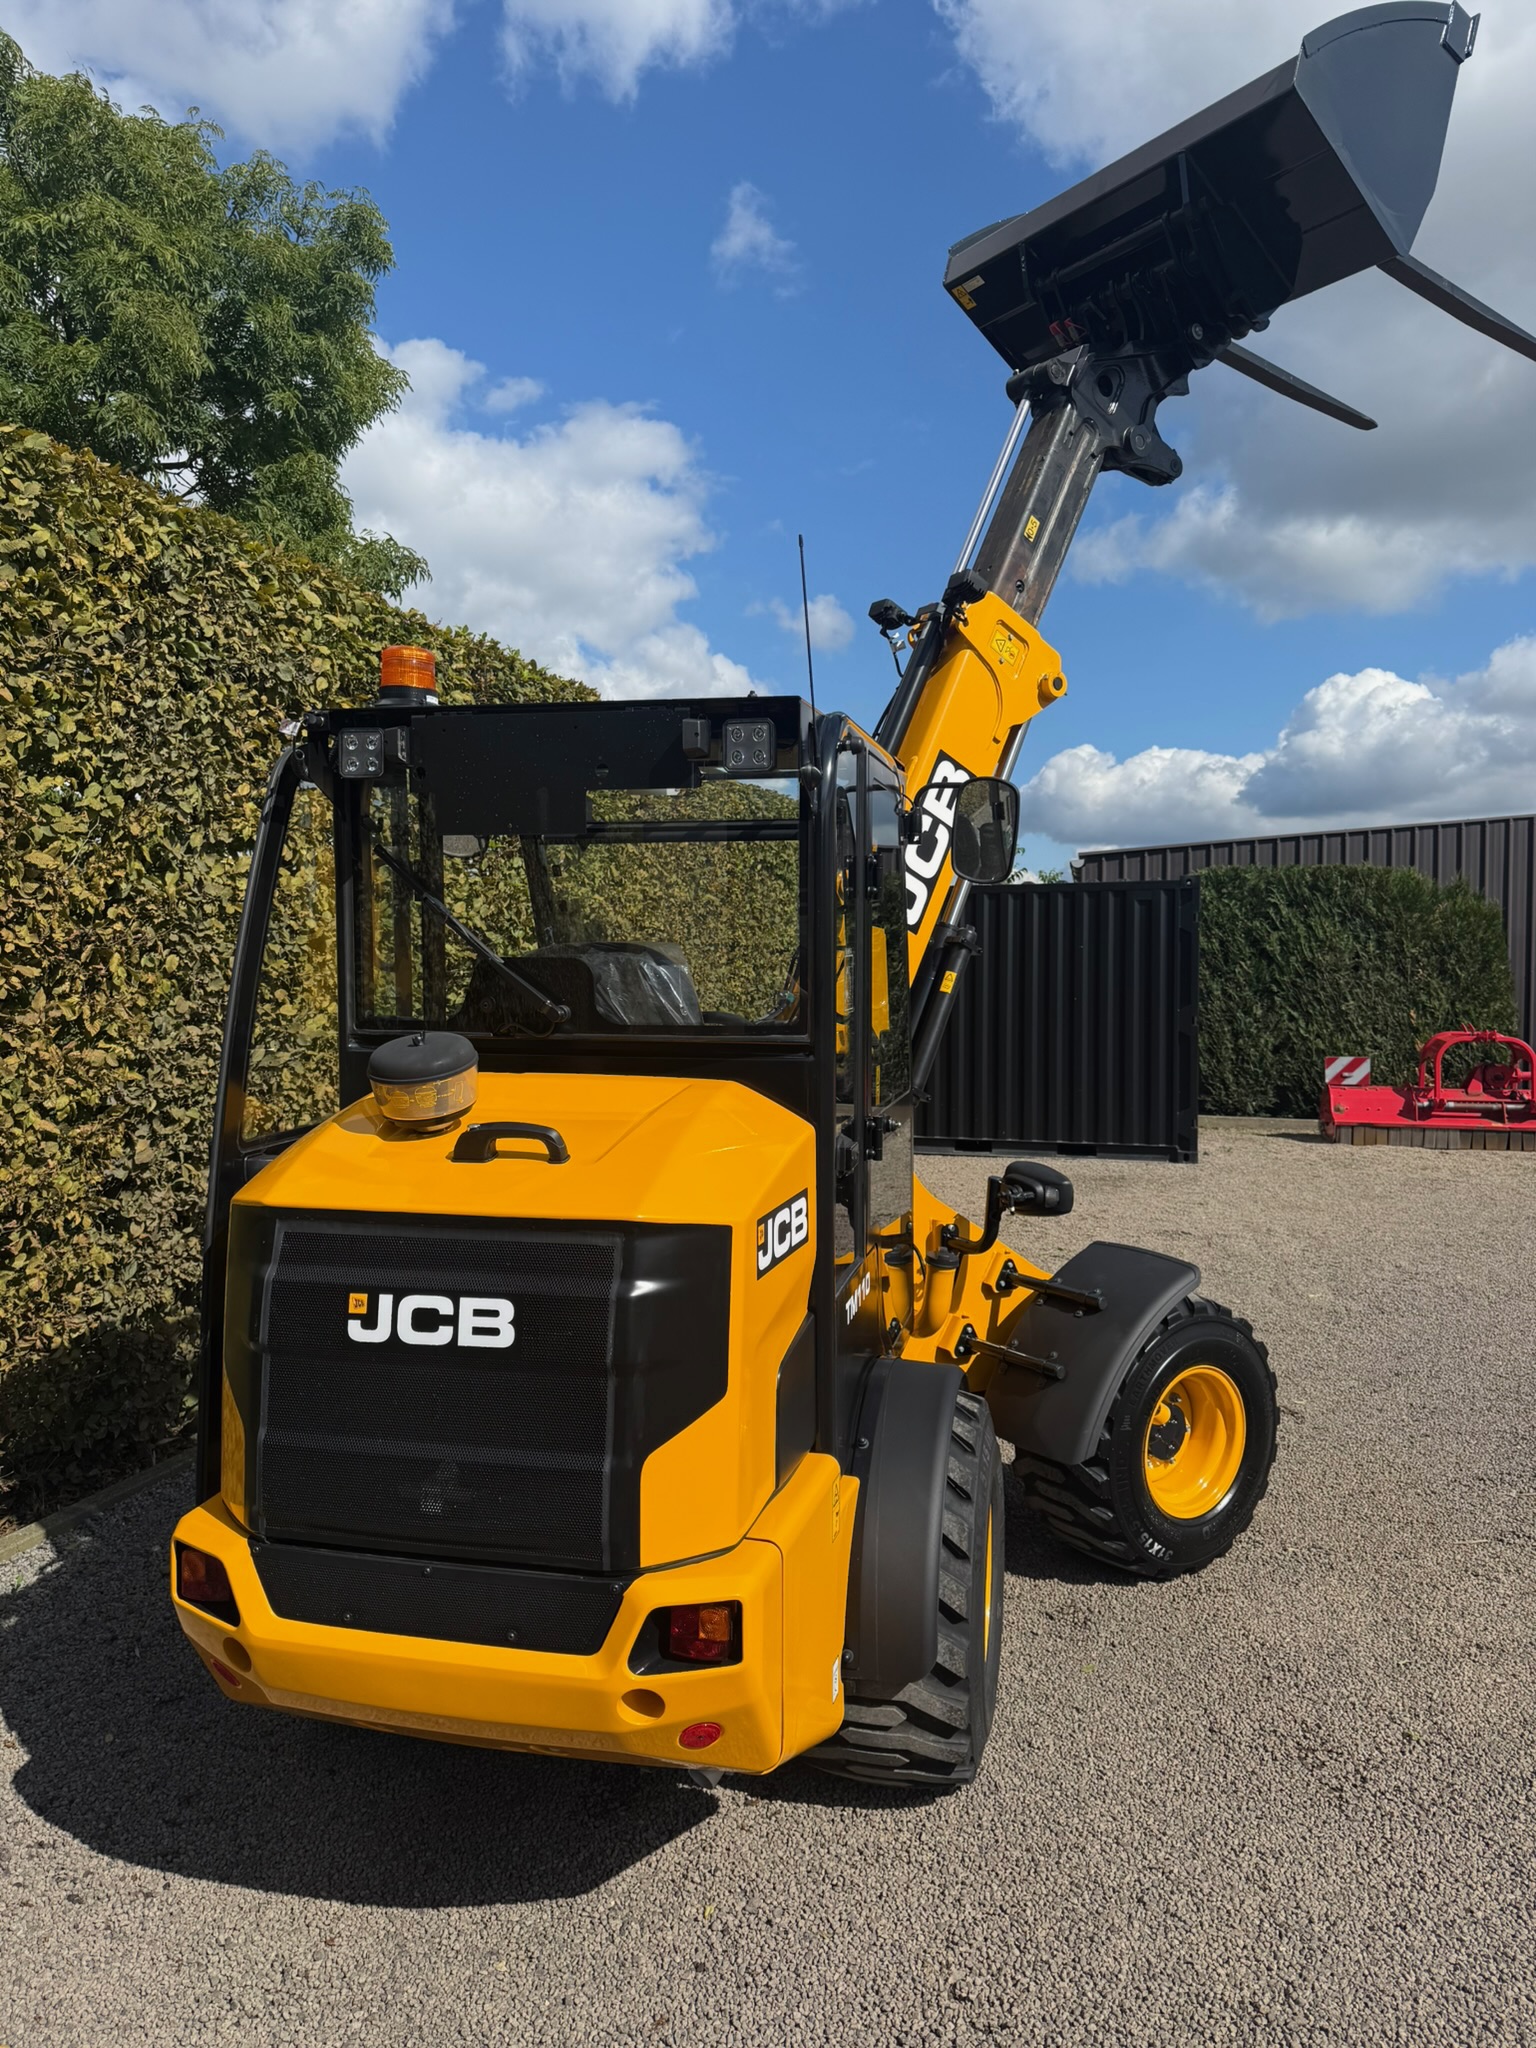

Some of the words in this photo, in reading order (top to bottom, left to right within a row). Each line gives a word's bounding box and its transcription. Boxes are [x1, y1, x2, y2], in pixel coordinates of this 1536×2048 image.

[758, 1196, 808, 1271] JCB
[347, 1293, 516, 1349] JCB
[845, 1271, 871, 1325] TM110
